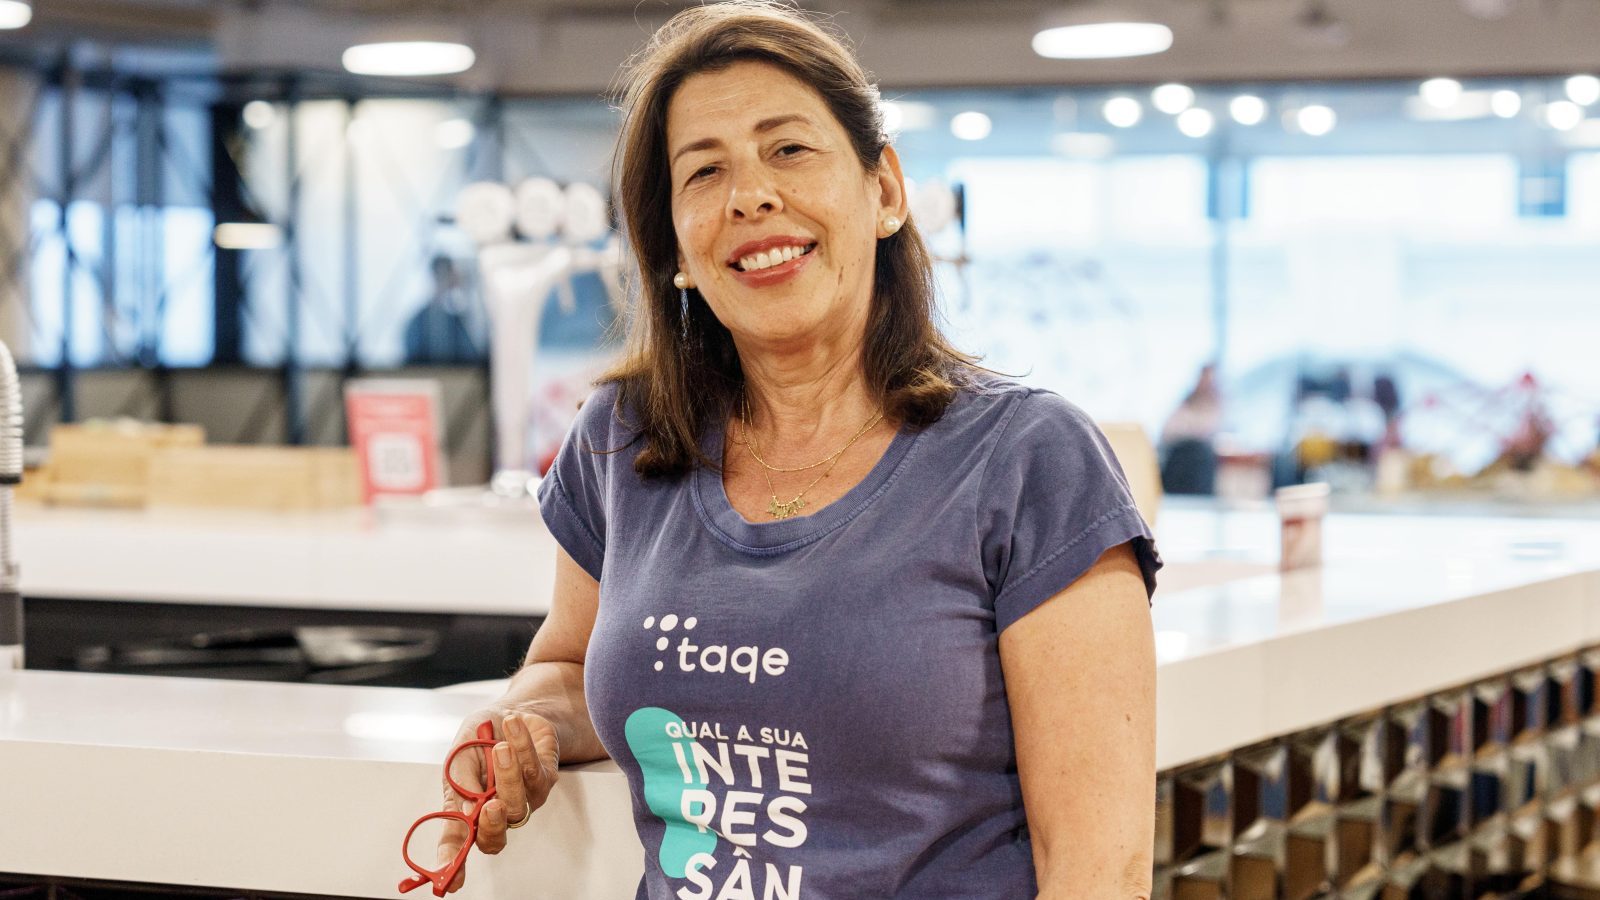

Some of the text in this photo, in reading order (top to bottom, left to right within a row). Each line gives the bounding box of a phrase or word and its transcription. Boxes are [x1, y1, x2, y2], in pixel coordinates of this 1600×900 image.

[677, 637, 789, 684] taqe
[665, 721, 809, 749] QUAL A SUA
[672, 742, 812, 794] INTE
[676, 846, 803, 900] SÂN
